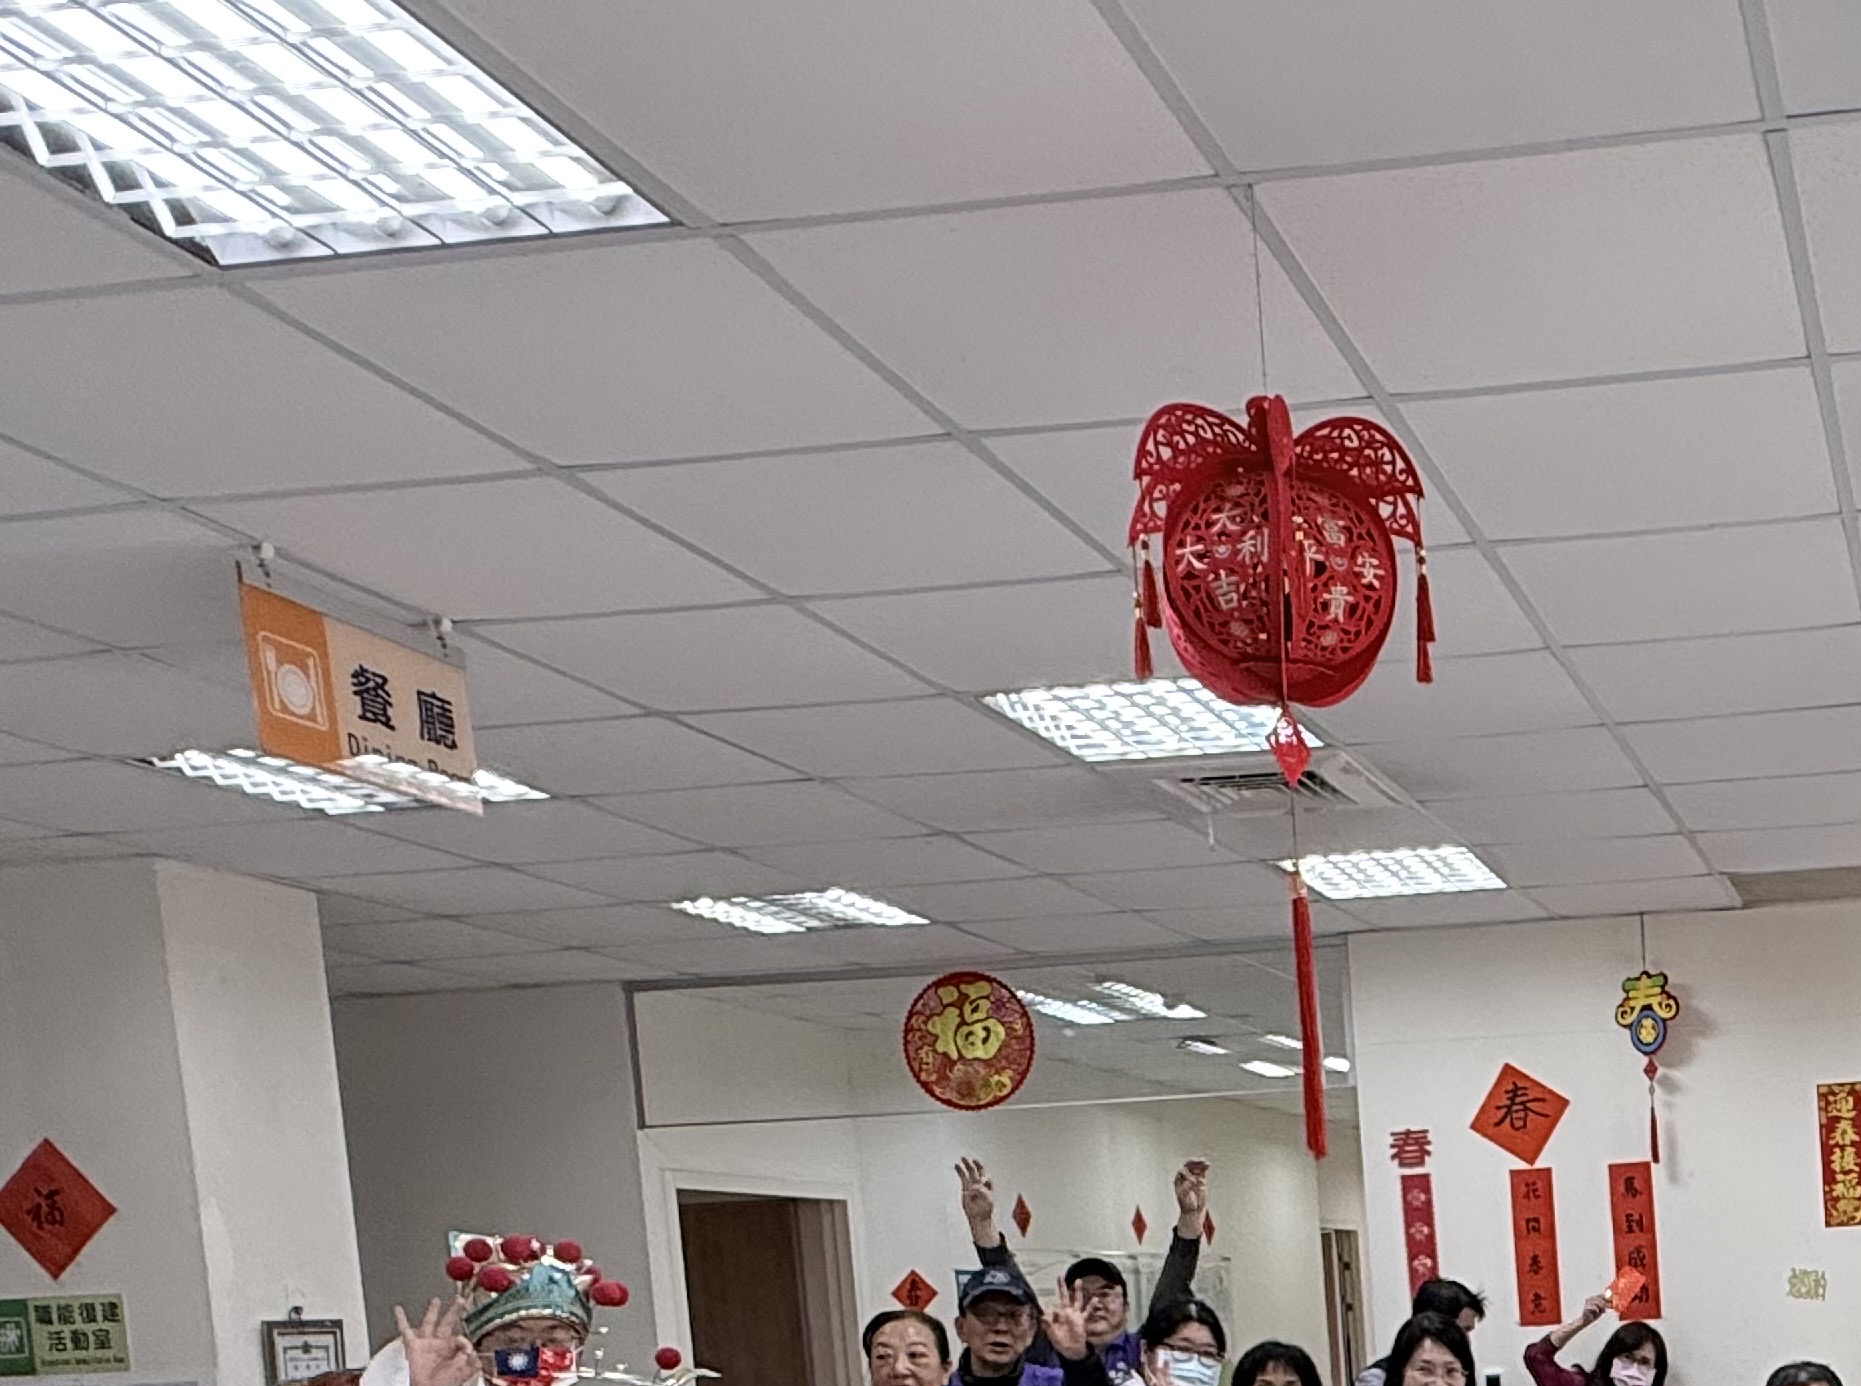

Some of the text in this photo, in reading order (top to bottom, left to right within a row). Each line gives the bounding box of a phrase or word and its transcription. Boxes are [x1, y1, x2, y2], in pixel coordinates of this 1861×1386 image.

[351, 663, 458, 749] 餐廳
[1494, 1082, 1550, 1132] 春
[1390, 1129, 1432, 1168] 春
[47, 1328, 113, 1352] 活動室
